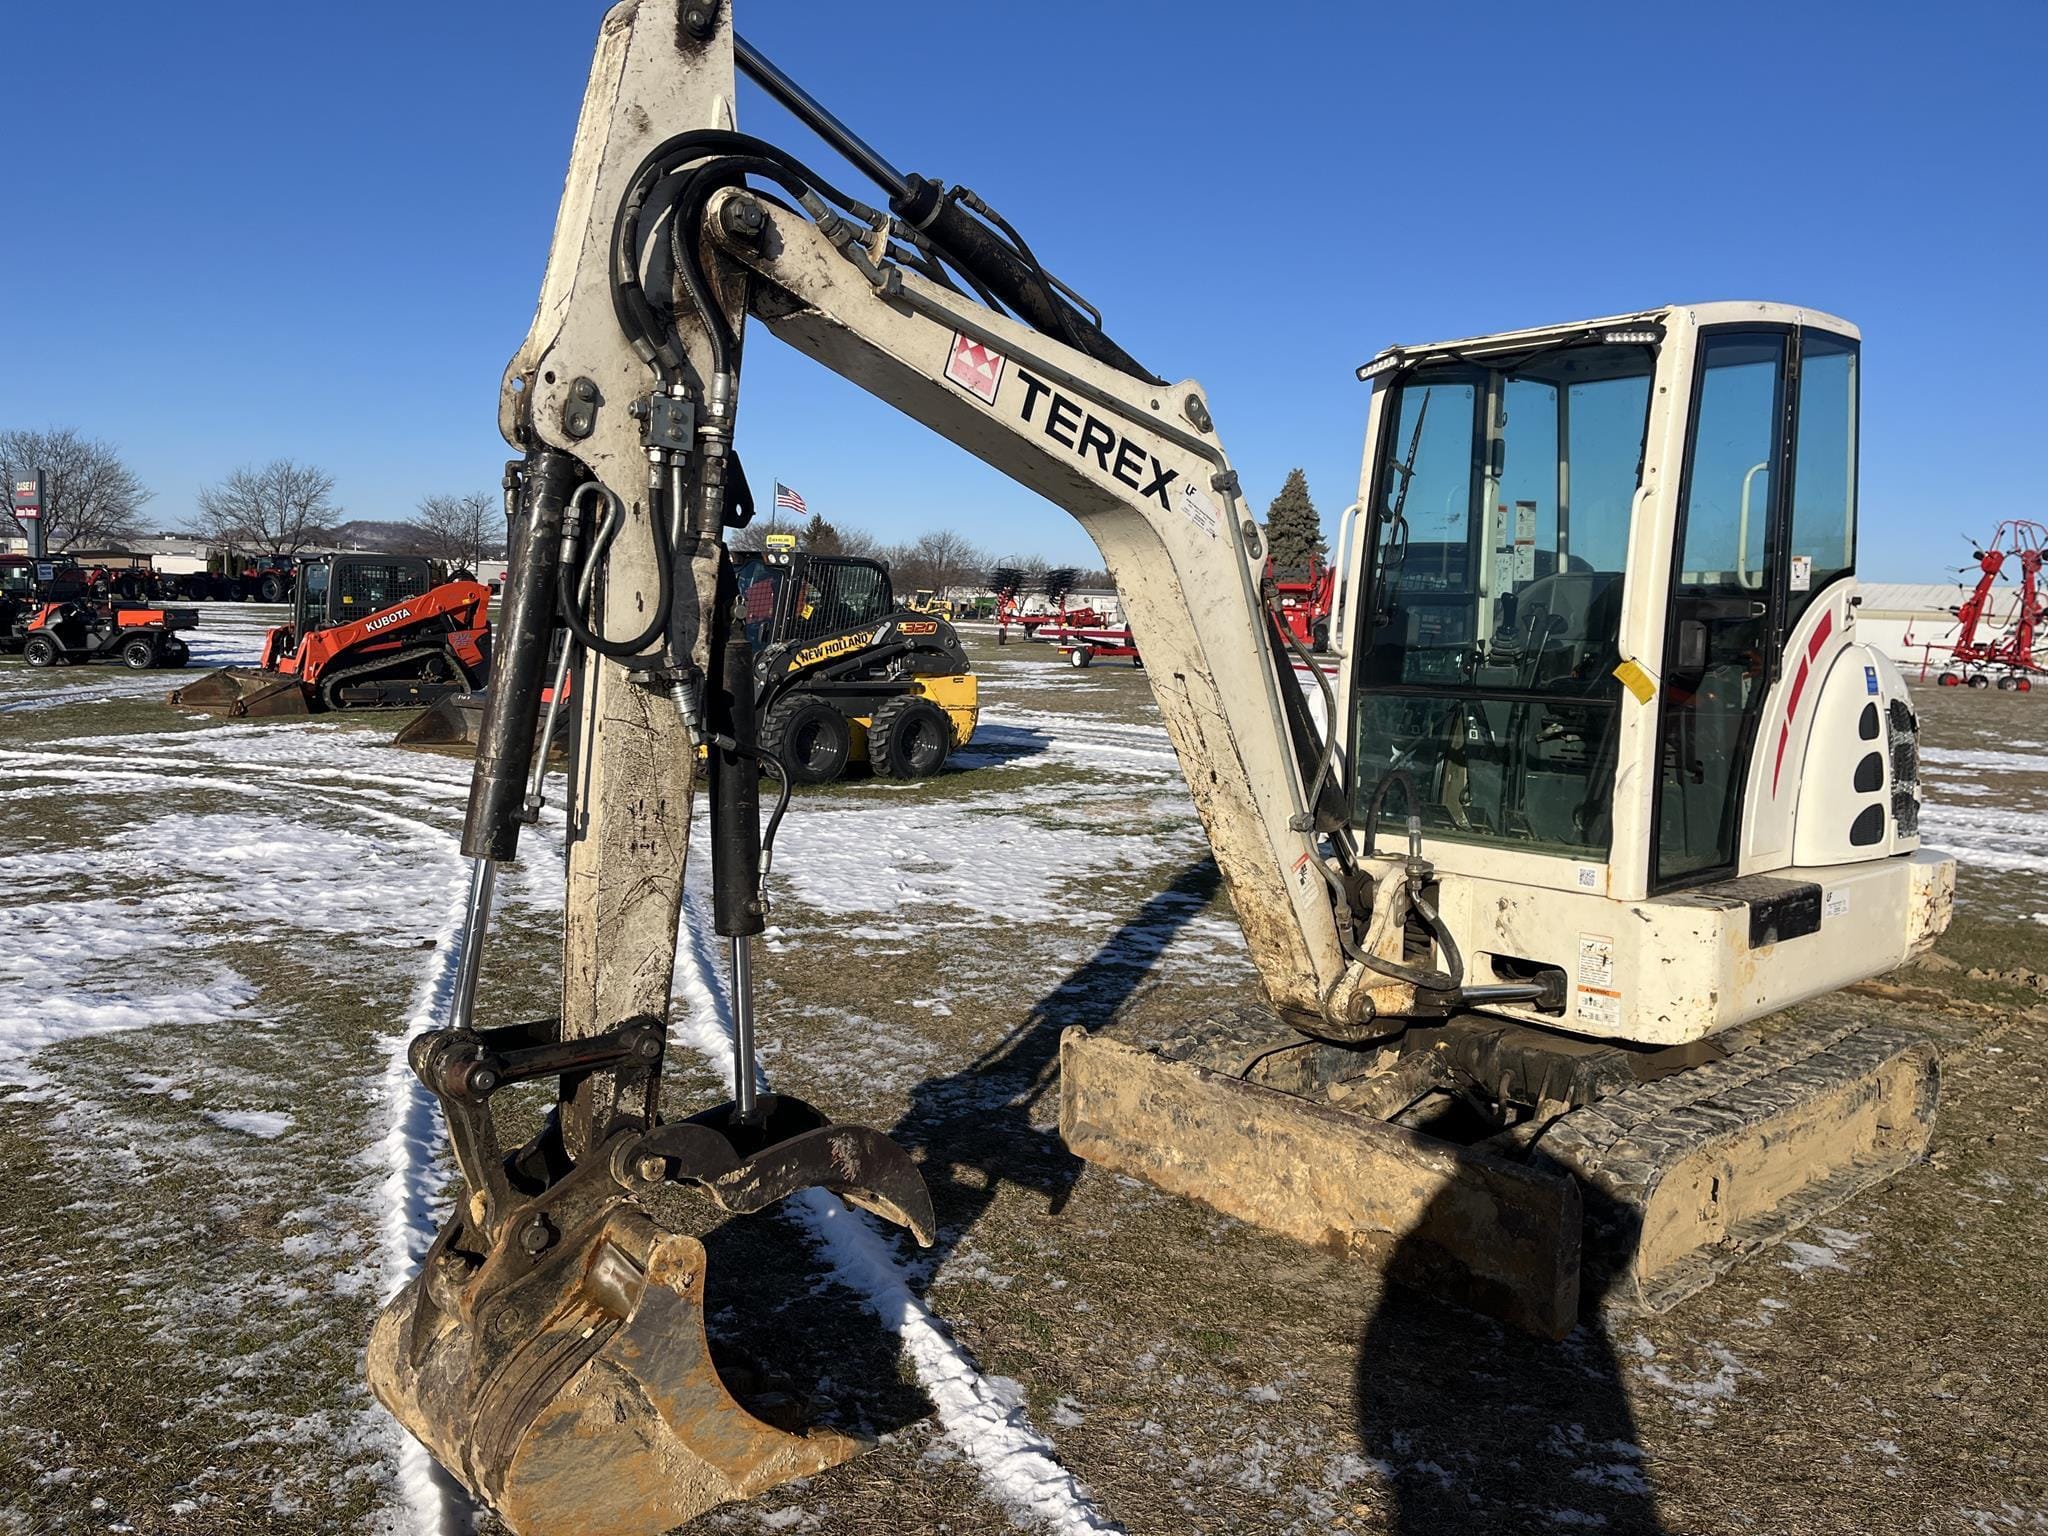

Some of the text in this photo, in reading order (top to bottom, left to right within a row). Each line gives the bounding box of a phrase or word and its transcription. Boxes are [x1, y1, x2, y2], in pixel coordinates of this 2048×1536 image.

[1017, 368, 1180, 512] TEREX
[1185, 483, 1197, 497] LF
[365, 608, 411, 632] KUBOTA
[897, 622, 937, 635] L320
[800, 633, 868, 663] NEW HOLLAND
